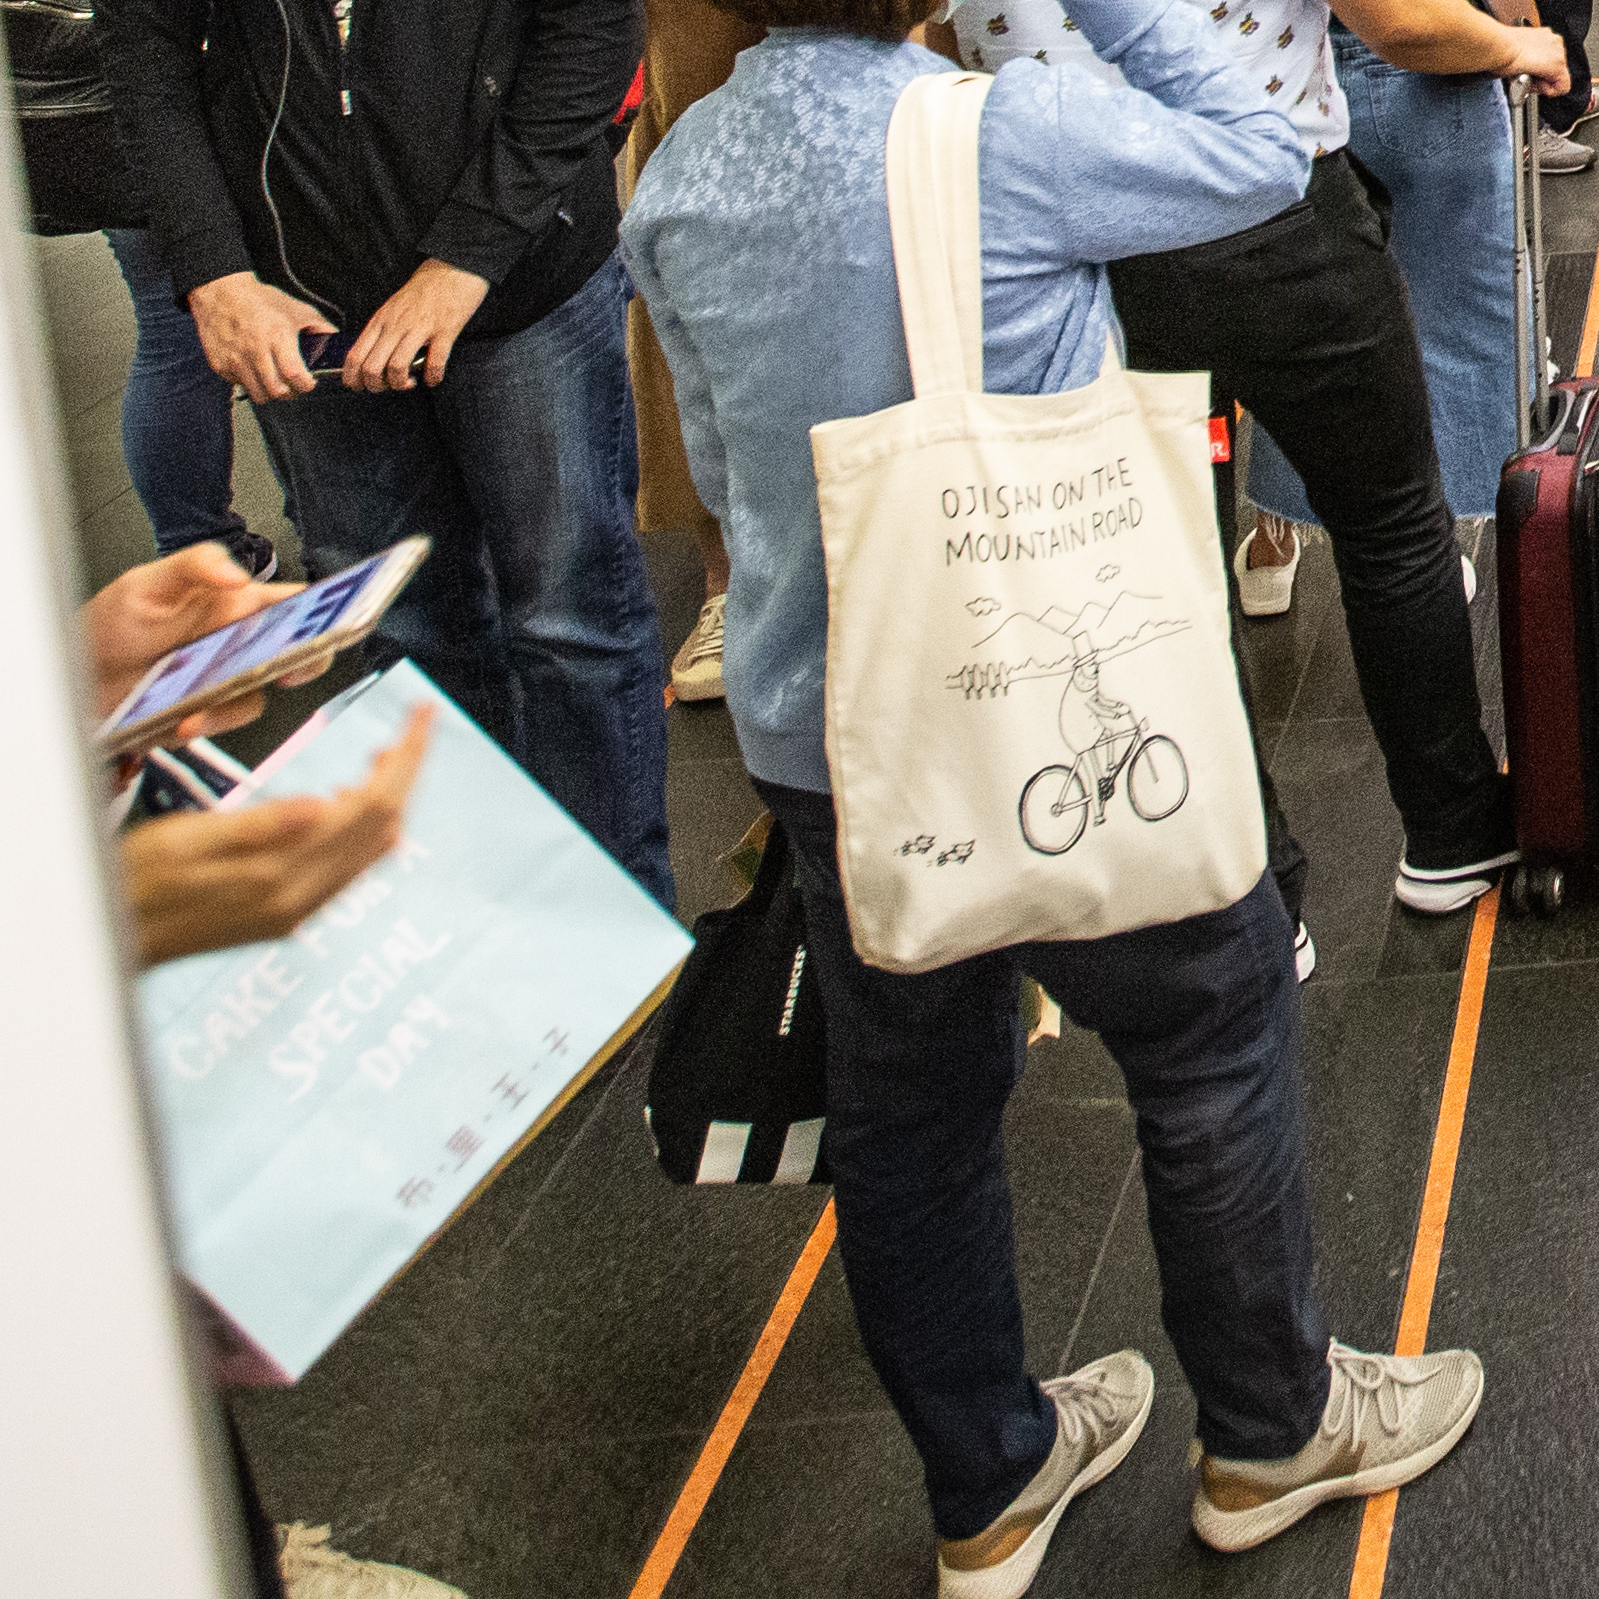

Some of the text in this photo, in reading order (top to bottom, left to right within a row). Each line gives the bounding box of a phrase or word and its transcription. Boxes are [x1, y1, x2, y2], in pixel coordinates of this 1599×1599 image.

[941, 456, 1135, 519] OJISAN ON THE
[945, 496, 1143, 567] MOUNTAIN ROAD
[167, 947, 305, 1082] CAKE
[266, 918, 453, 1104] SPECIAL
[355, 993, 452, 1092] DAY
